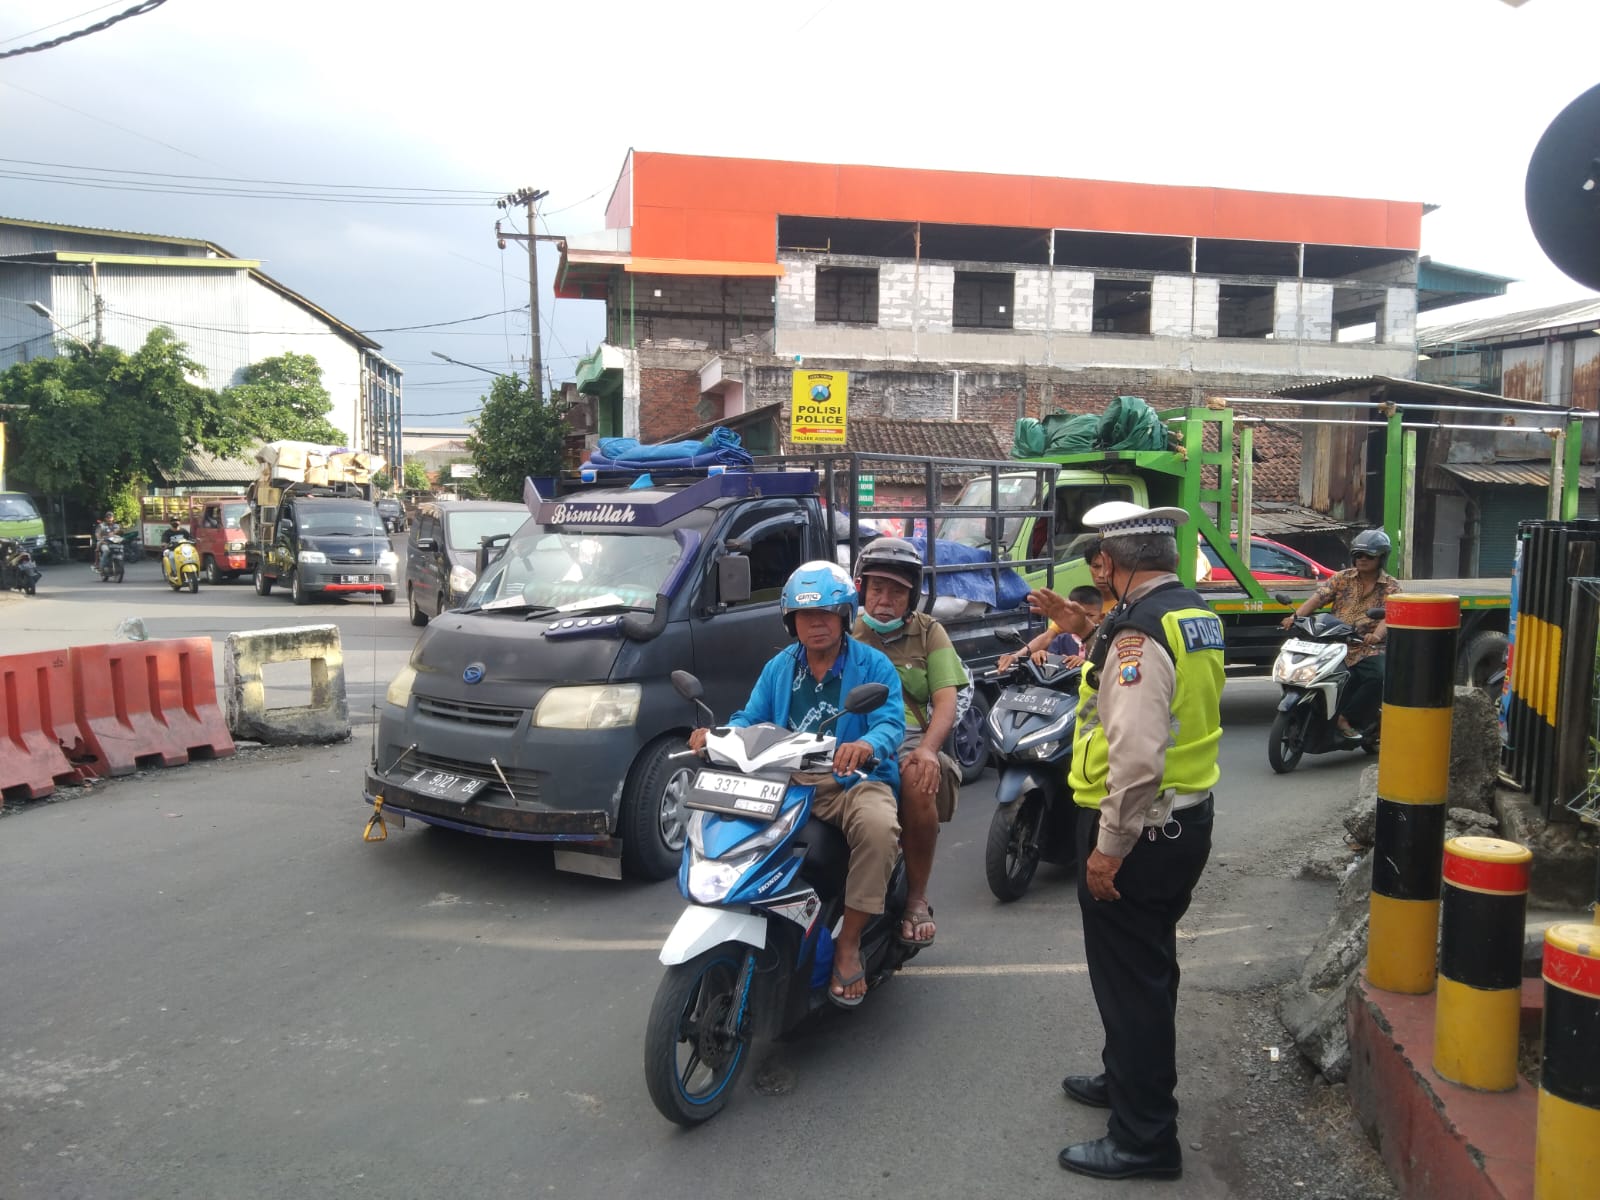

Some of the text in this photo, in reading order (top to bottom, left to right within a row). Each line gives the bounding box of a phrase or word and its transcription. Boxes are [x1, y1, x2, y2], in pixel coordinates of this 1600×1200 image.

[795, 415, 843, 424] POLICE
[798, 405, 841, 415] POLISI
[551, 503, 636, 525] Bismillah
[1013, 694, 1038, 704] 4265
[412, 770, 427, 782] L
[428, 774, 460, 789] 9021
[461, 780, 481, 794] BL
[697, 775, 782, 801] L 337 RM
[757, 871, 784, 894] HONDA
